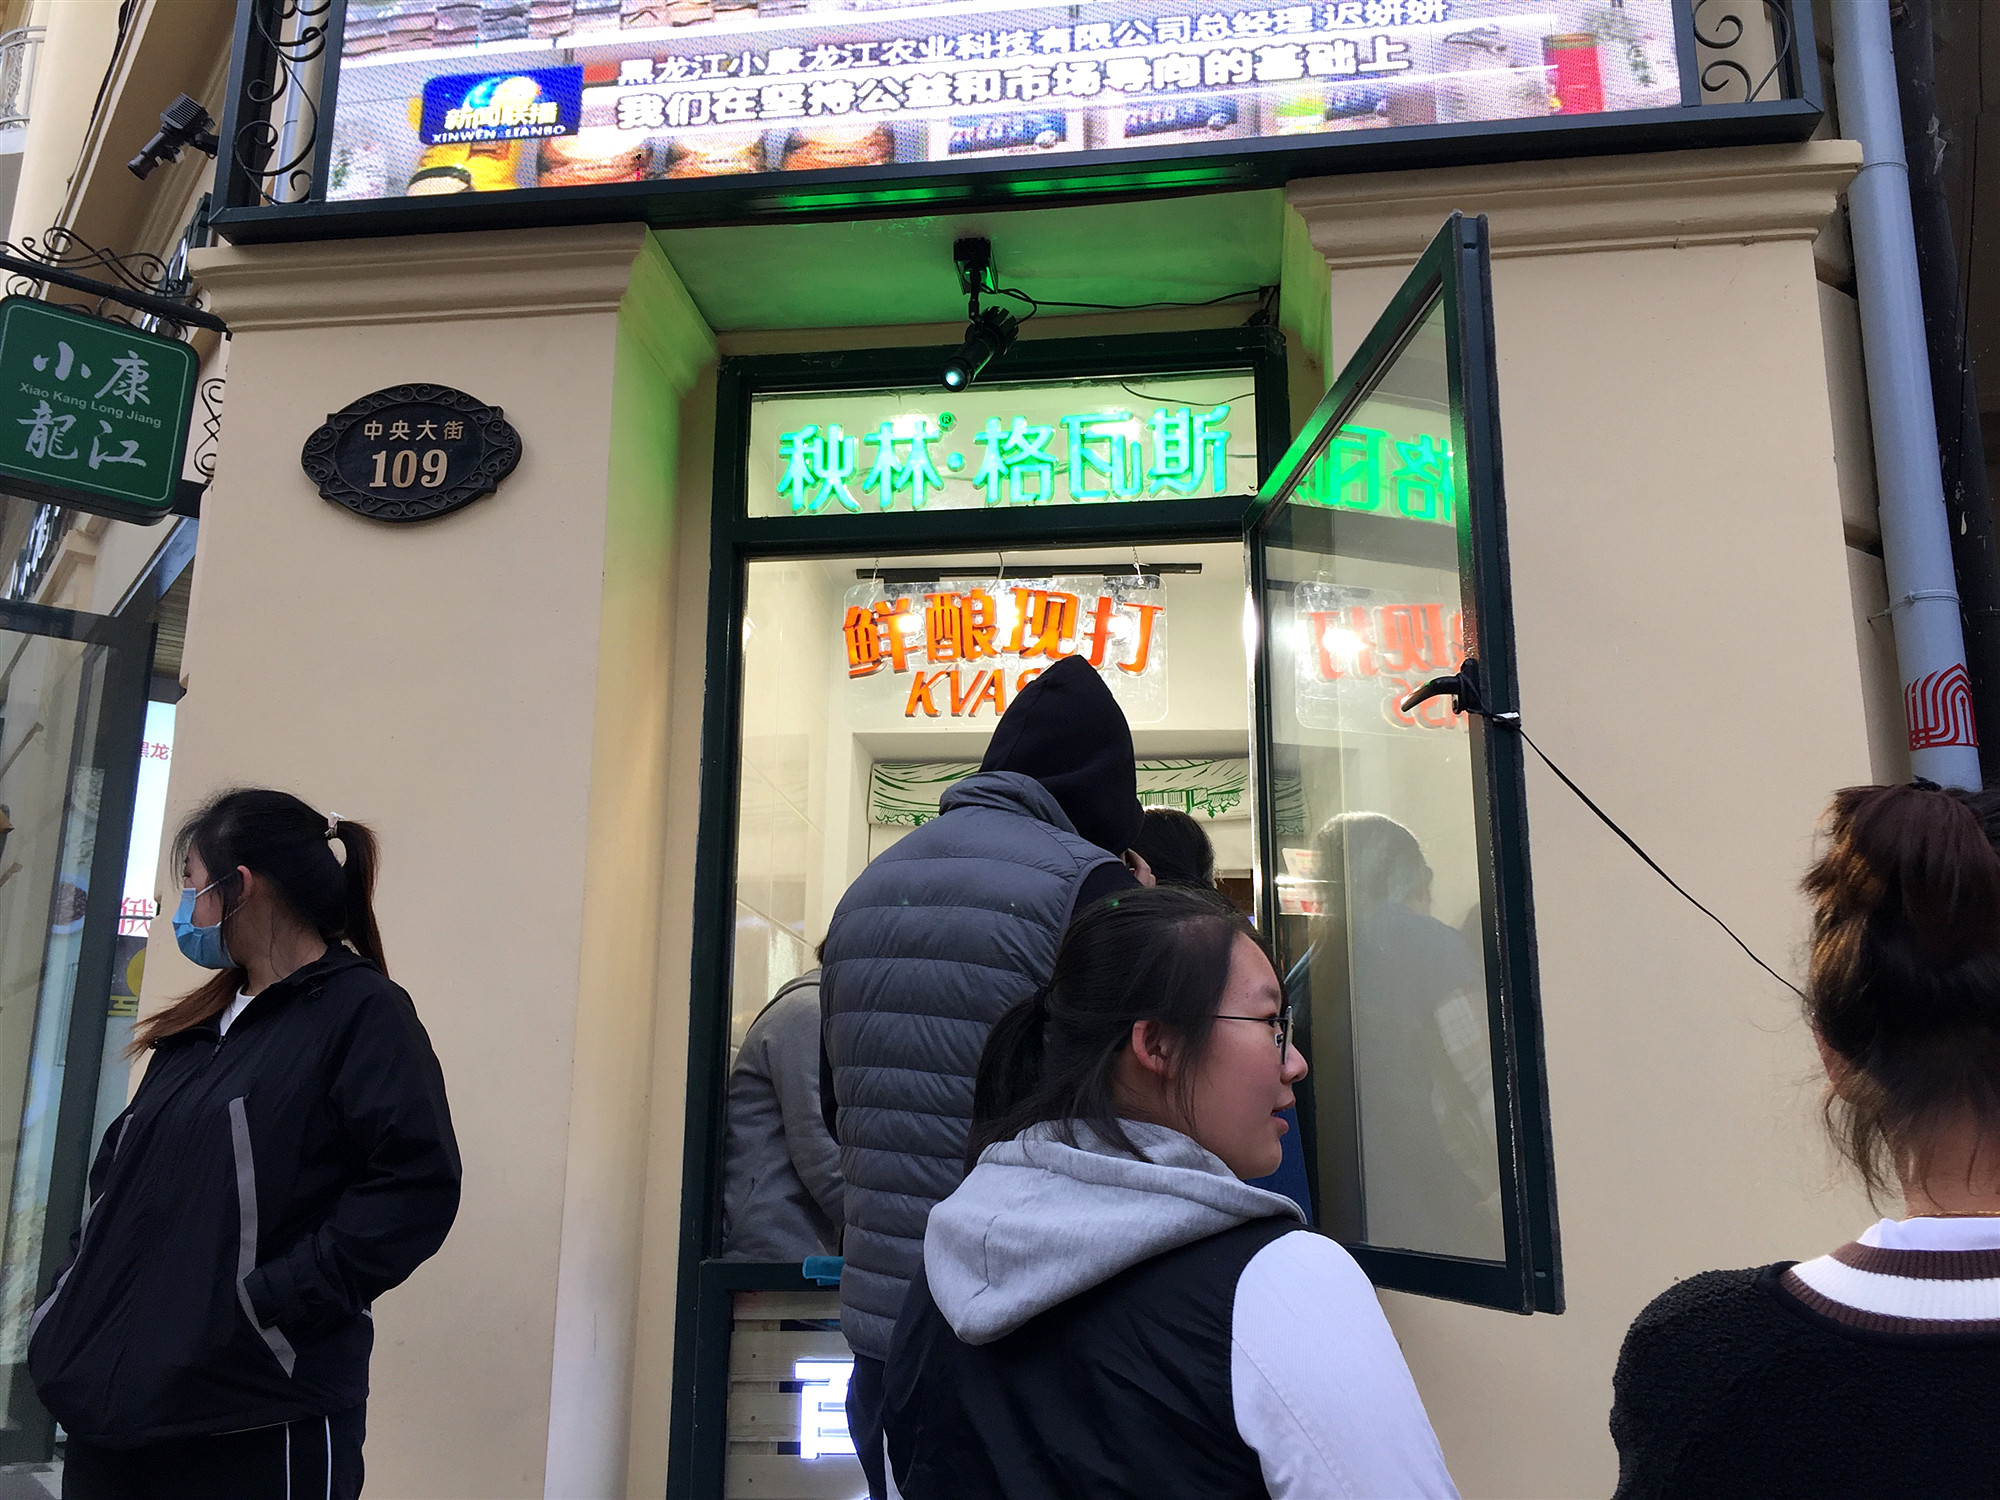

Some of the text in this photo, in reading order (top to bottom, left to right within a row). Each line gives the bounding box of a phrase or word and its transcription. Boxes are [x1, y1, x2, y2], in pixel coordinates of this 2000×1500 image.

[617, 5, 1314, 87] 黑龙江小康龙江农业科技有限公司总经理
[617, 35, 1412, 130] 我们在坚持公益和市场导向的基础上
[432, 124, 567, 144] XINWEN LIANBO
[444, 101, 558, 131] 新闻联播
[33, 340, 151, 405] 小康
[19, 382, 163, 430] Xiao Kang Long Jiang
[364, 420, 464, 441] 中央大街
[369, 449, 448, 488] 109
[843, 587, 1166, 680] 鲜酿现打
[141, 742, 172, 760] 黑龙
